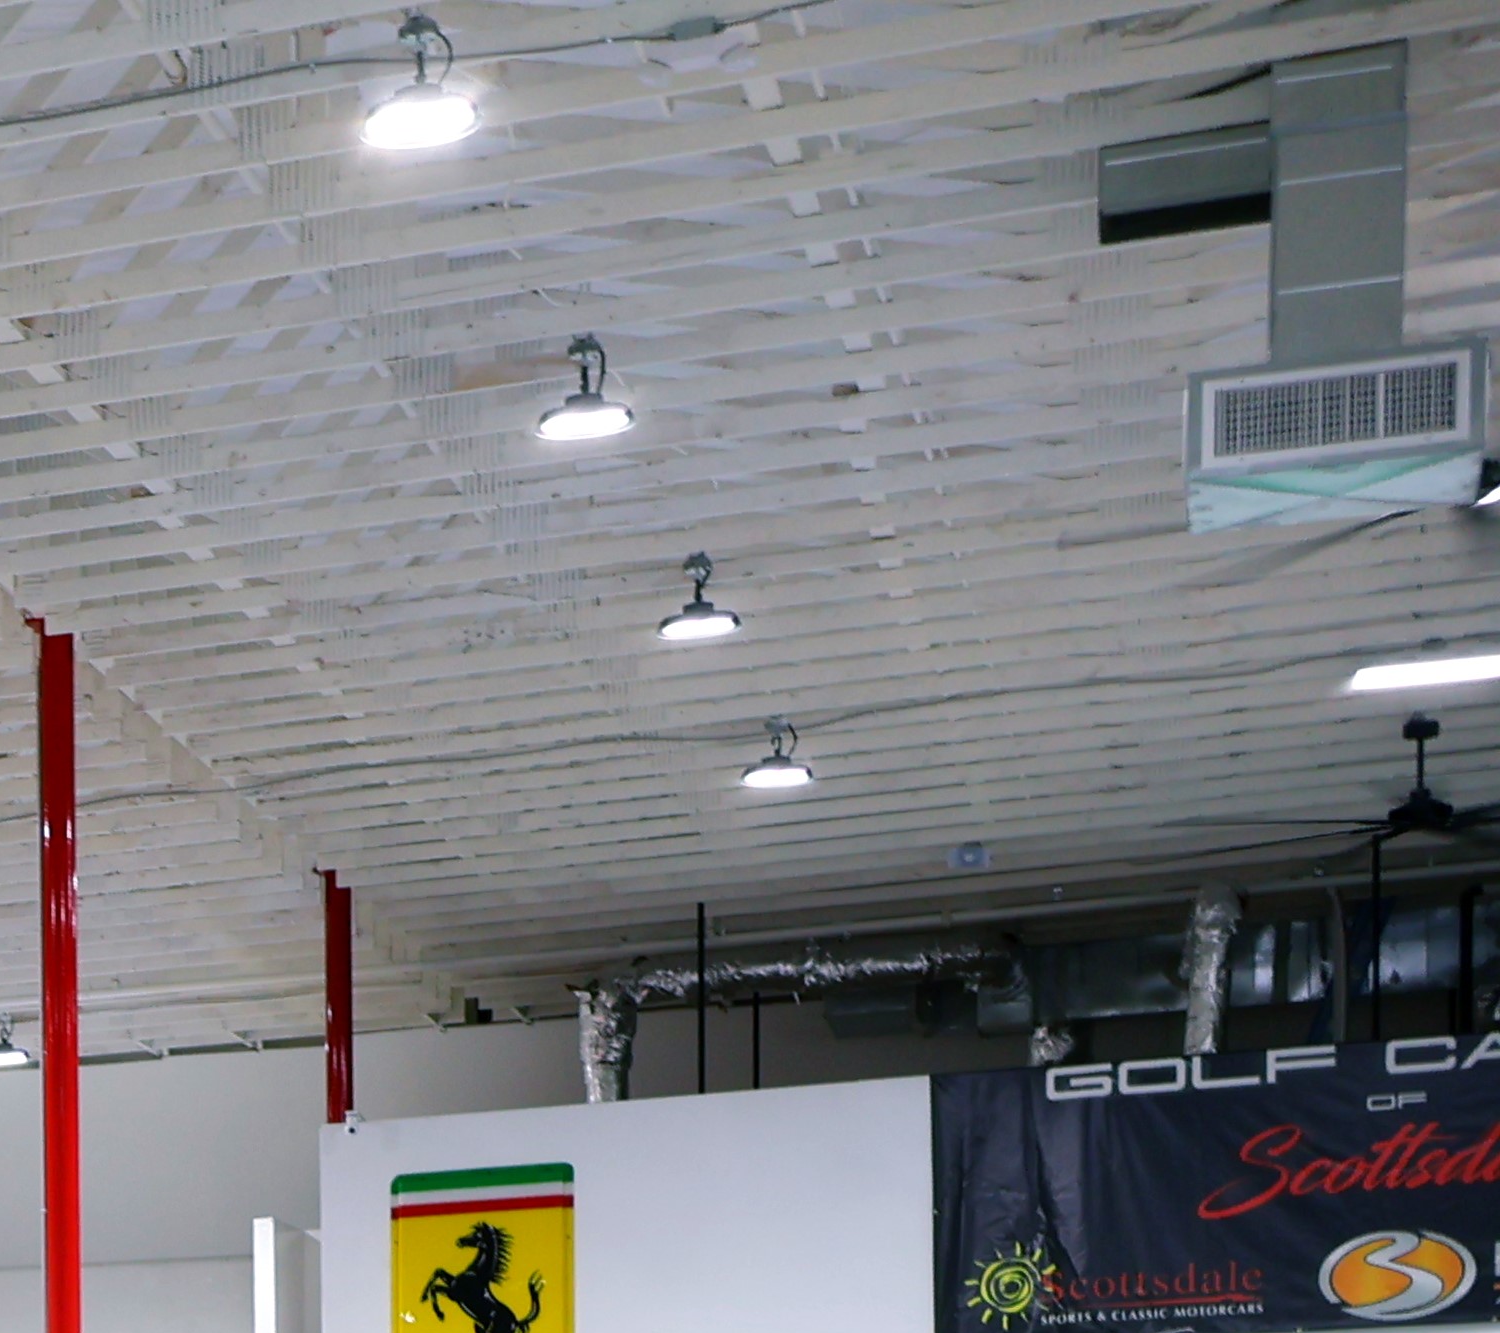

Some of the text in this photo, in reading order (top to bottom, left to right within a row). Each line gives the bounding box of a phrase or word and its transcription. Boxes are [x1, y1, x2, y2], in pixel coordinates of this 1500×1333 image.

[1045, 1045, 1337, 1101] GOLF
[1366, 1091, 1428, 1112] OF
[1041, 1259, 1264, 1303] Scottsdale
[1040, 1302, 1265, 1326] SPORTS & CLASSIC MOTORCARS
